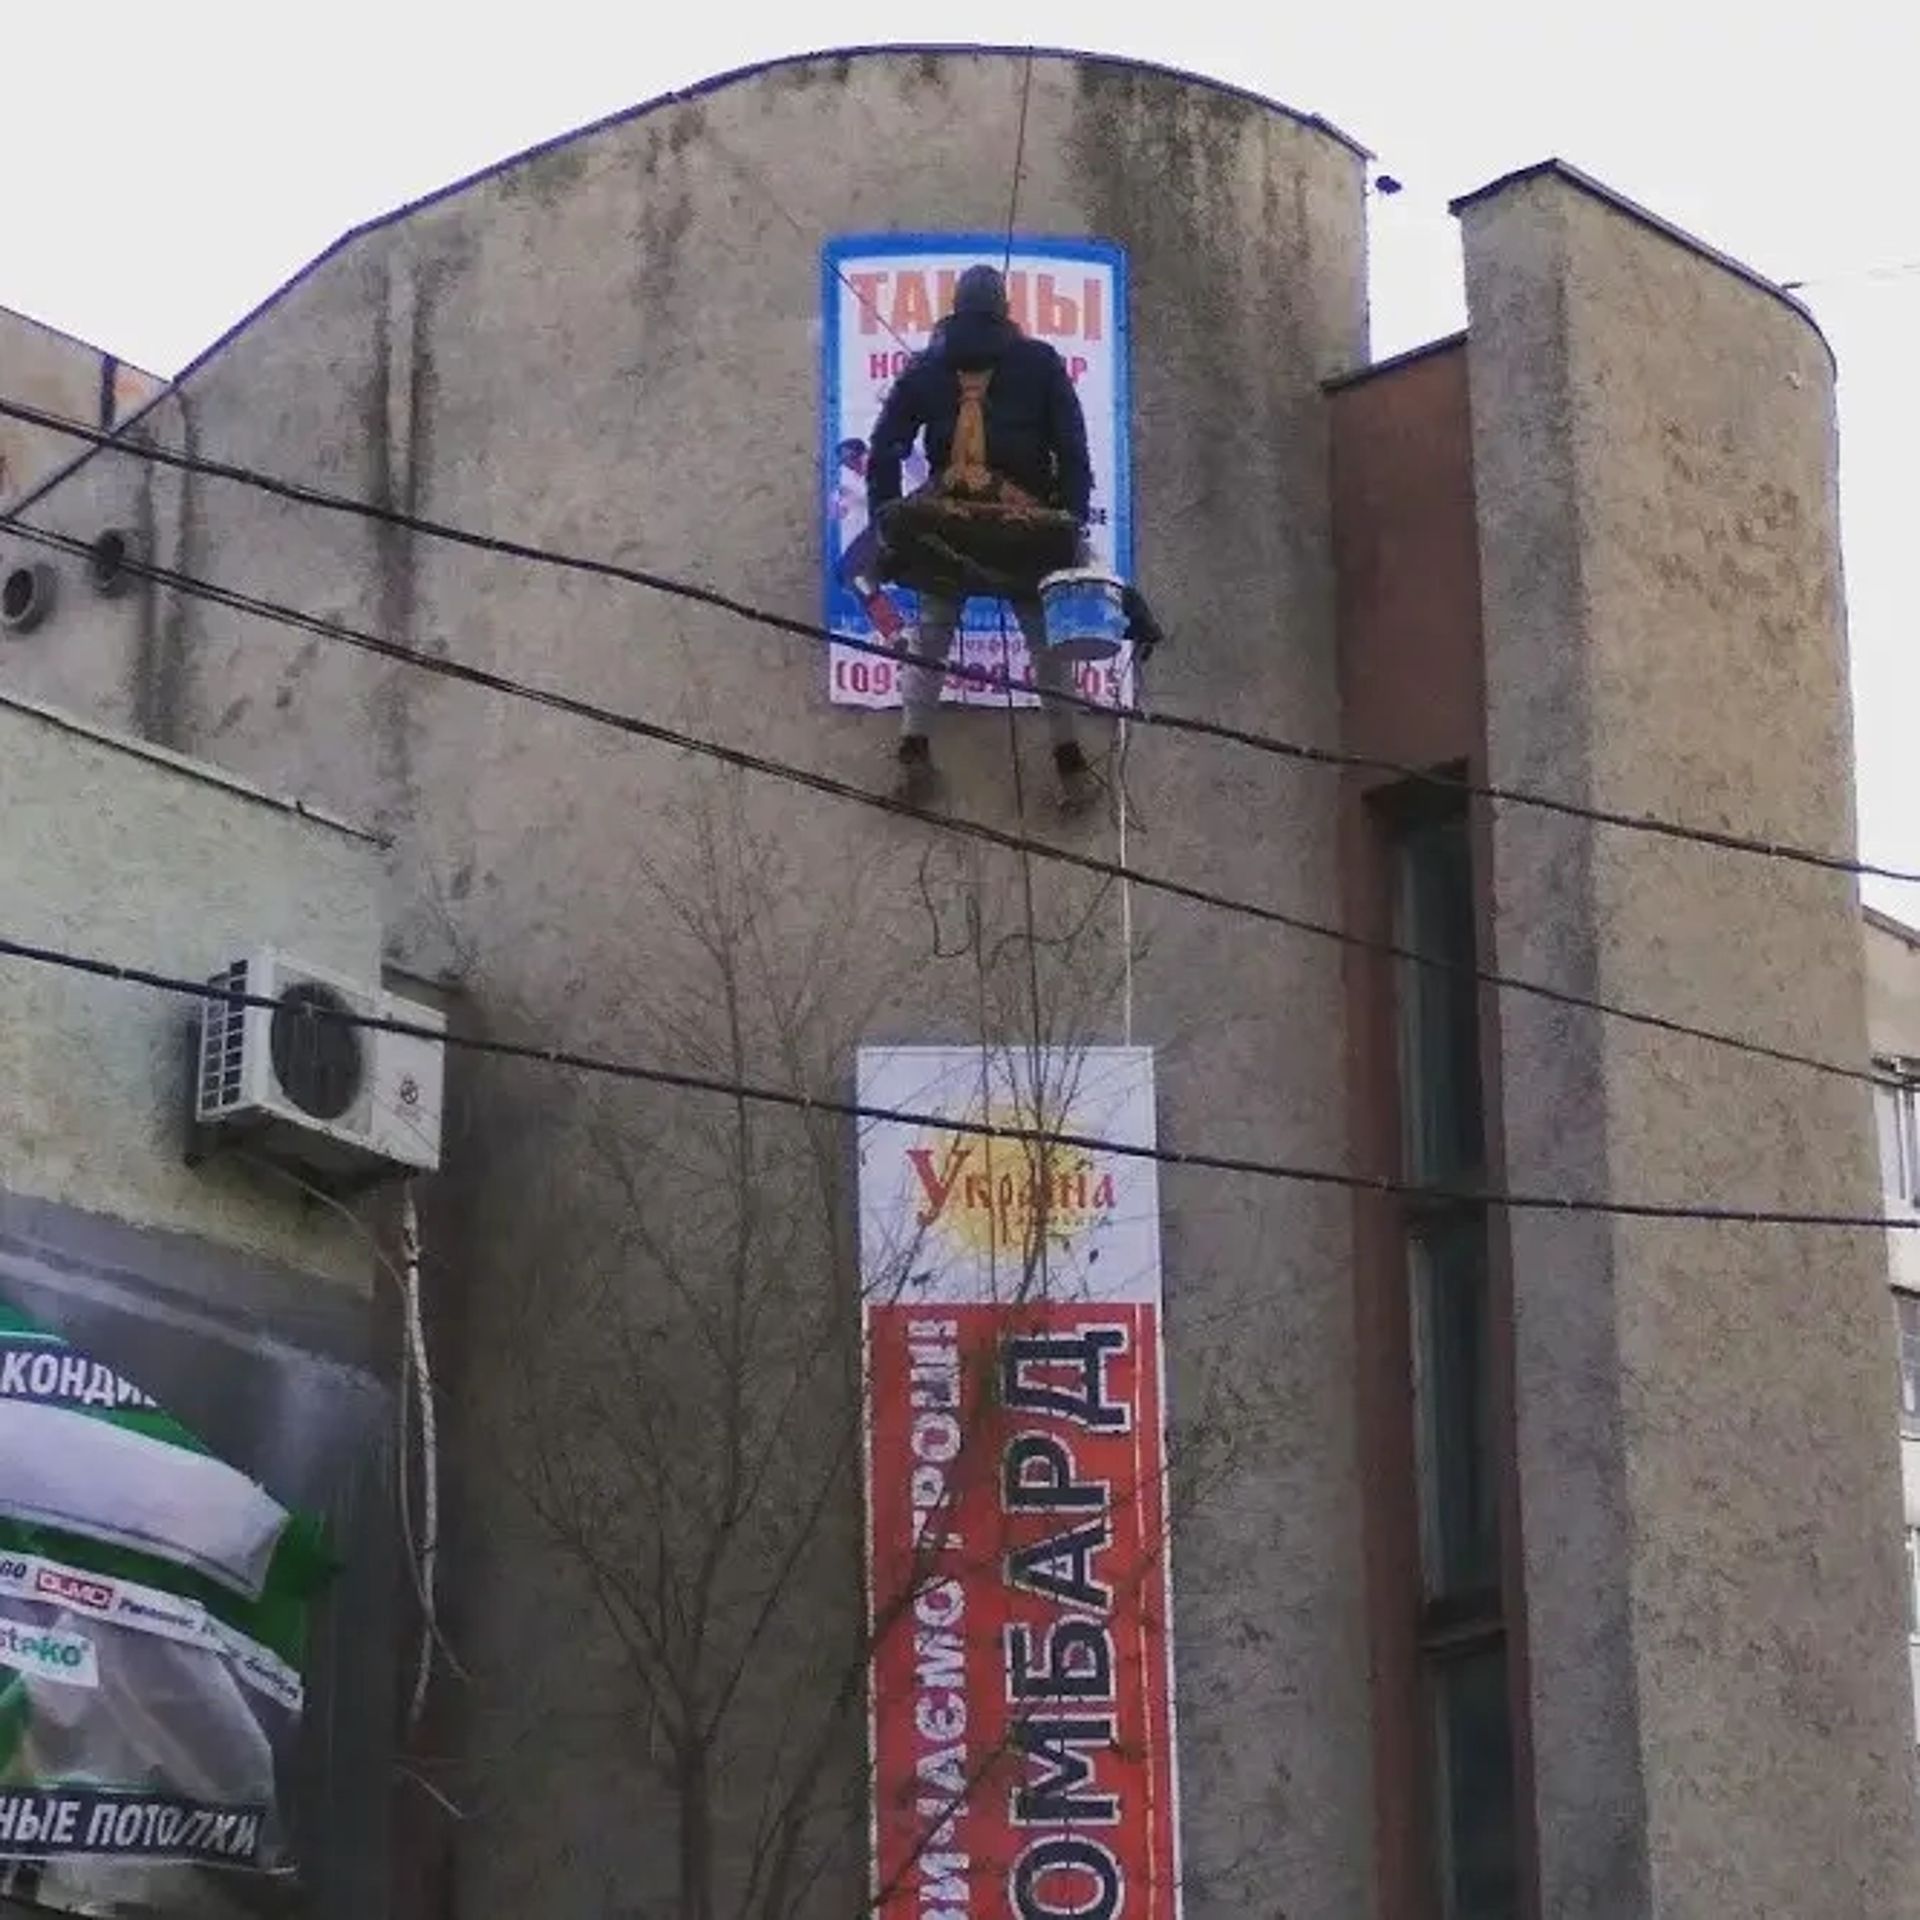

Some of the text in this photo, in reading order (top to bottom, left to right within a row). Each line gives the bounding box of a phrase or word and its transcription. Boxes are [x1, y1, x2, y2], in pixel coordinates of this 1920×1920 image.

[906, 1149, 1116, 1243] Укрна
[2, 1351, 157, 1407] КОНДИ
[86, 1803, 257, 1857] ПОТОЛКИ
